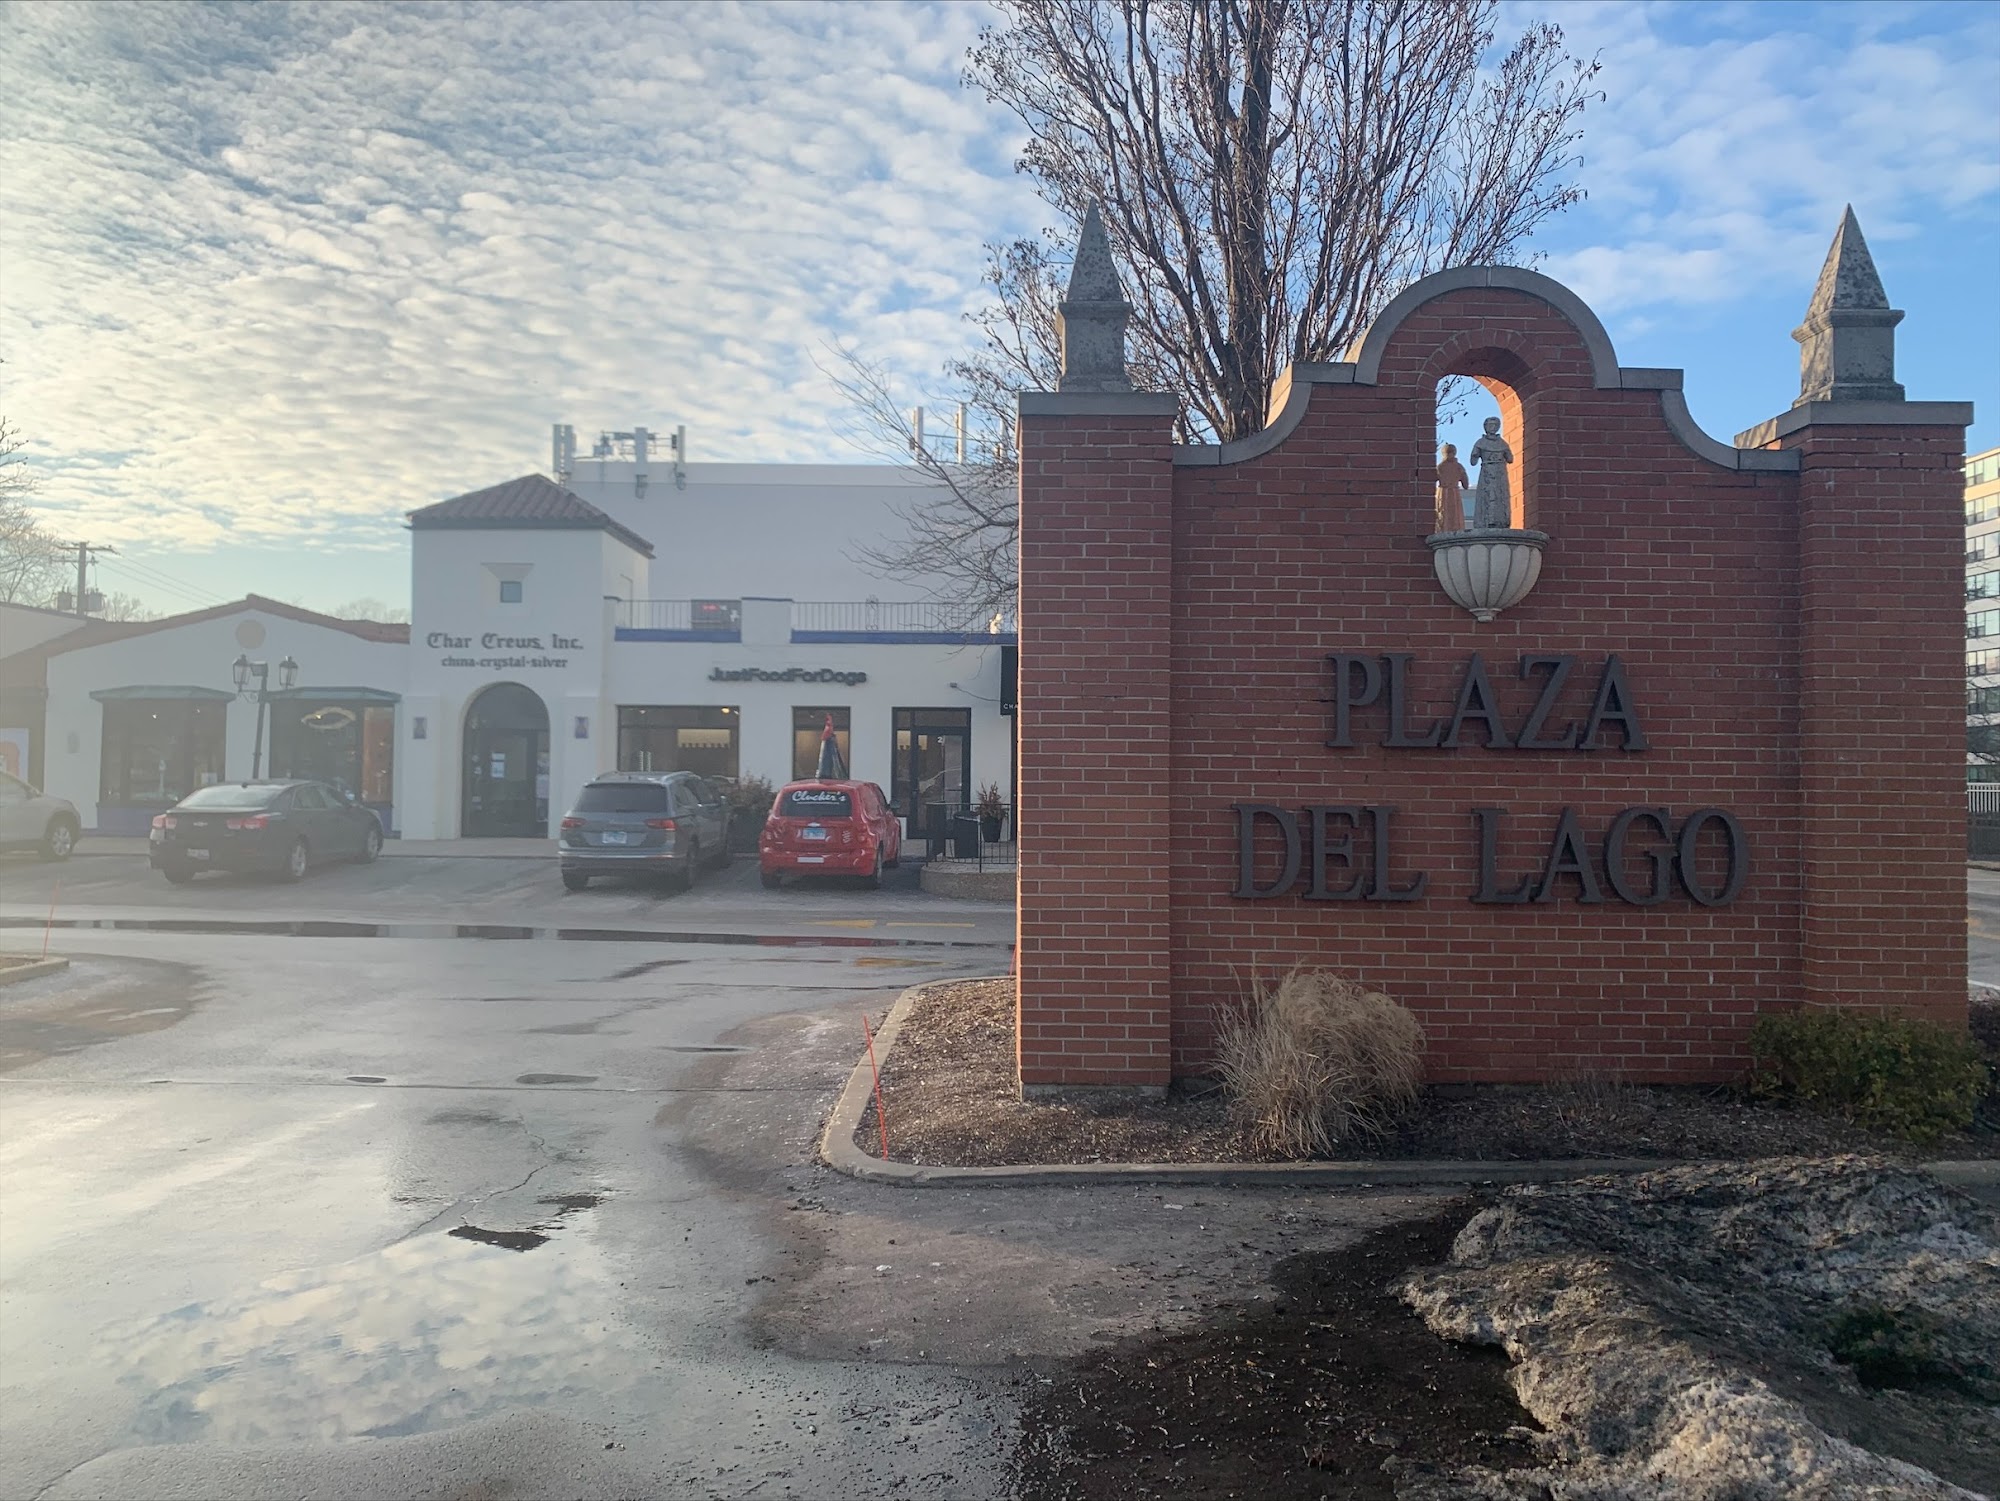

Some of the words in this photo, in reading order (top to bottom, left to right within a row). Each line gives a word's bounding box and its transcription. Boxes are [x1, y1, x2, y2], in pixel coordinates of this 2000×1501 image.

[427, 632, 472, 649] Char
[552, 633, 584, 650] Inc.
[708, 667, 867, 686] JustFoodForDogs
[1326, 652, 1650, 752] PLAZA
[792, 790, 847, 802] Clucker's
[1231, 803, 1428, 901] DEL
[1470, 807, 1750, 905] LAGO
